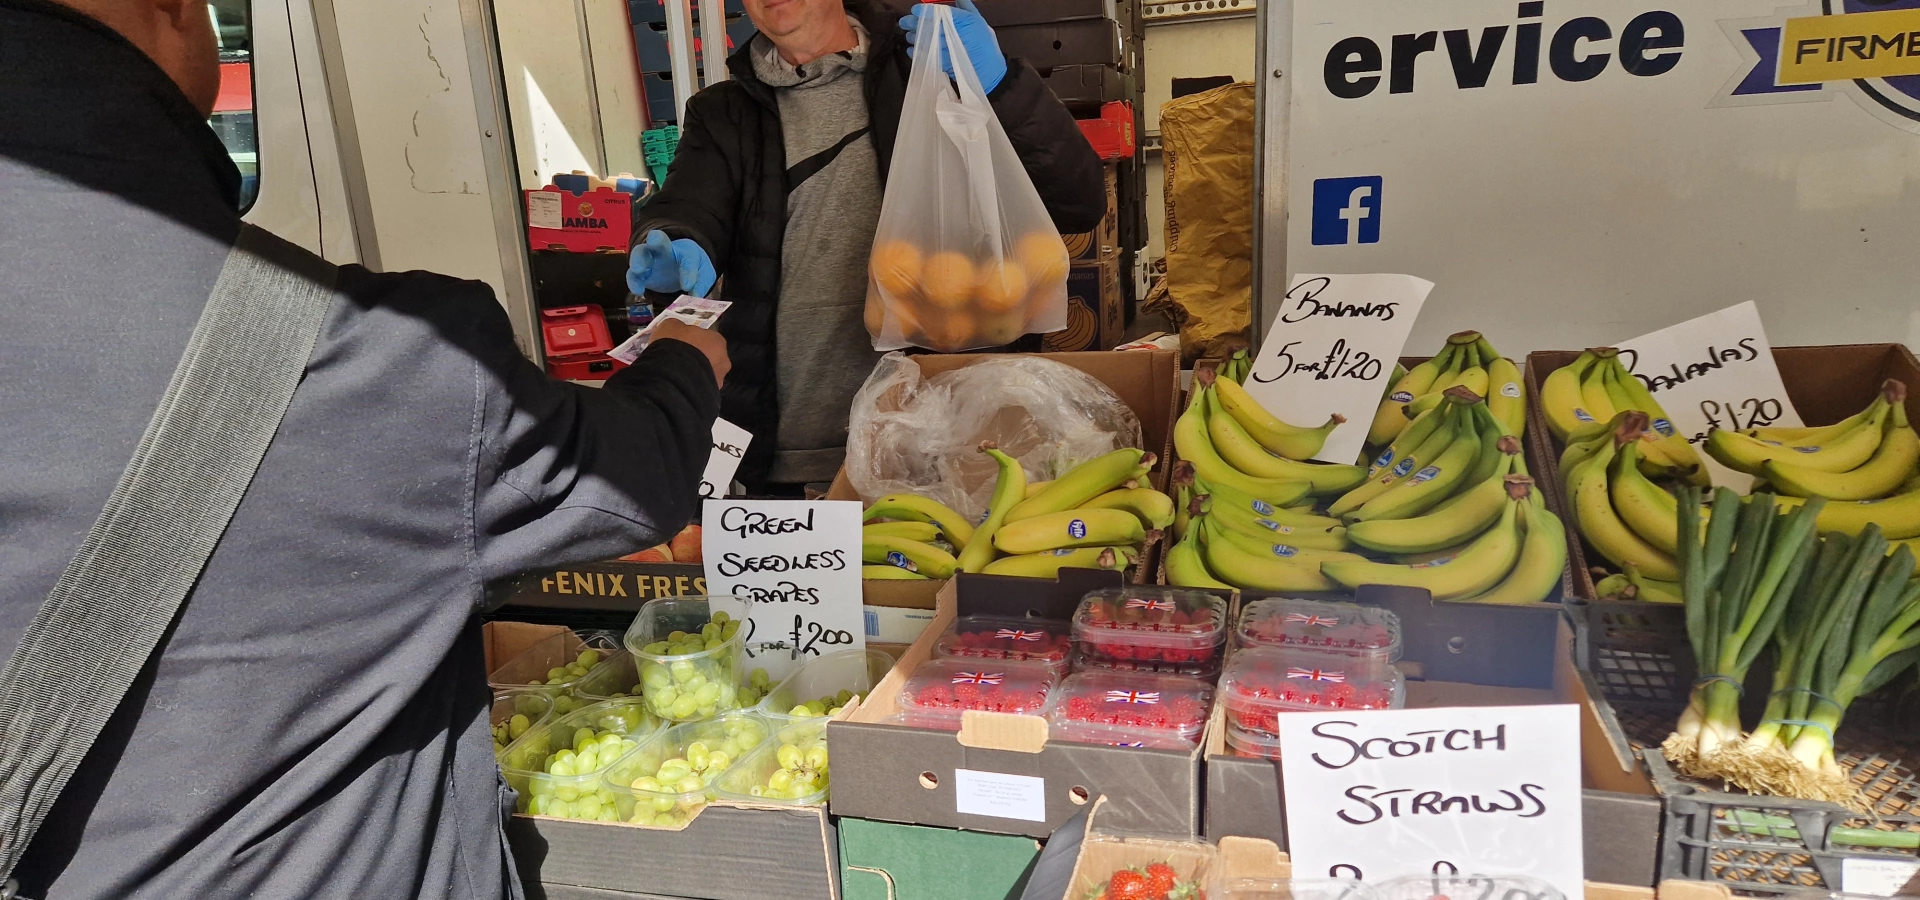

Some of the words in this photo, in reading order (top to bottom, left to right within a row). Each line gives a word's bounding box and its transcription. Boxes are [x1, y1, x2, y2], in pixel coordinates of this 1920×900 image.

[1323, 1, 1685, 99] ervice
[1795, 32, 1920, 64] FIRME
[562, 217, 608, 229] AMBA
[1167, 200, 1180, 253] Chipping
[1070, 272, 1095, 280] nanas
[1282, 277, 1400, 323] BANANAS
[1252, 341, 1302, 383] 5
[721, 506, 814, 539] GREEN
[717, 549, 846, 577] SEEDLESS
[541, 571, 628, 597] FENIX
[732, 581, 819, 605] GRAPES
[1311, 720, 1506, 769] SCOTCH
[1337, 784, 1546, 825] STRAWS
